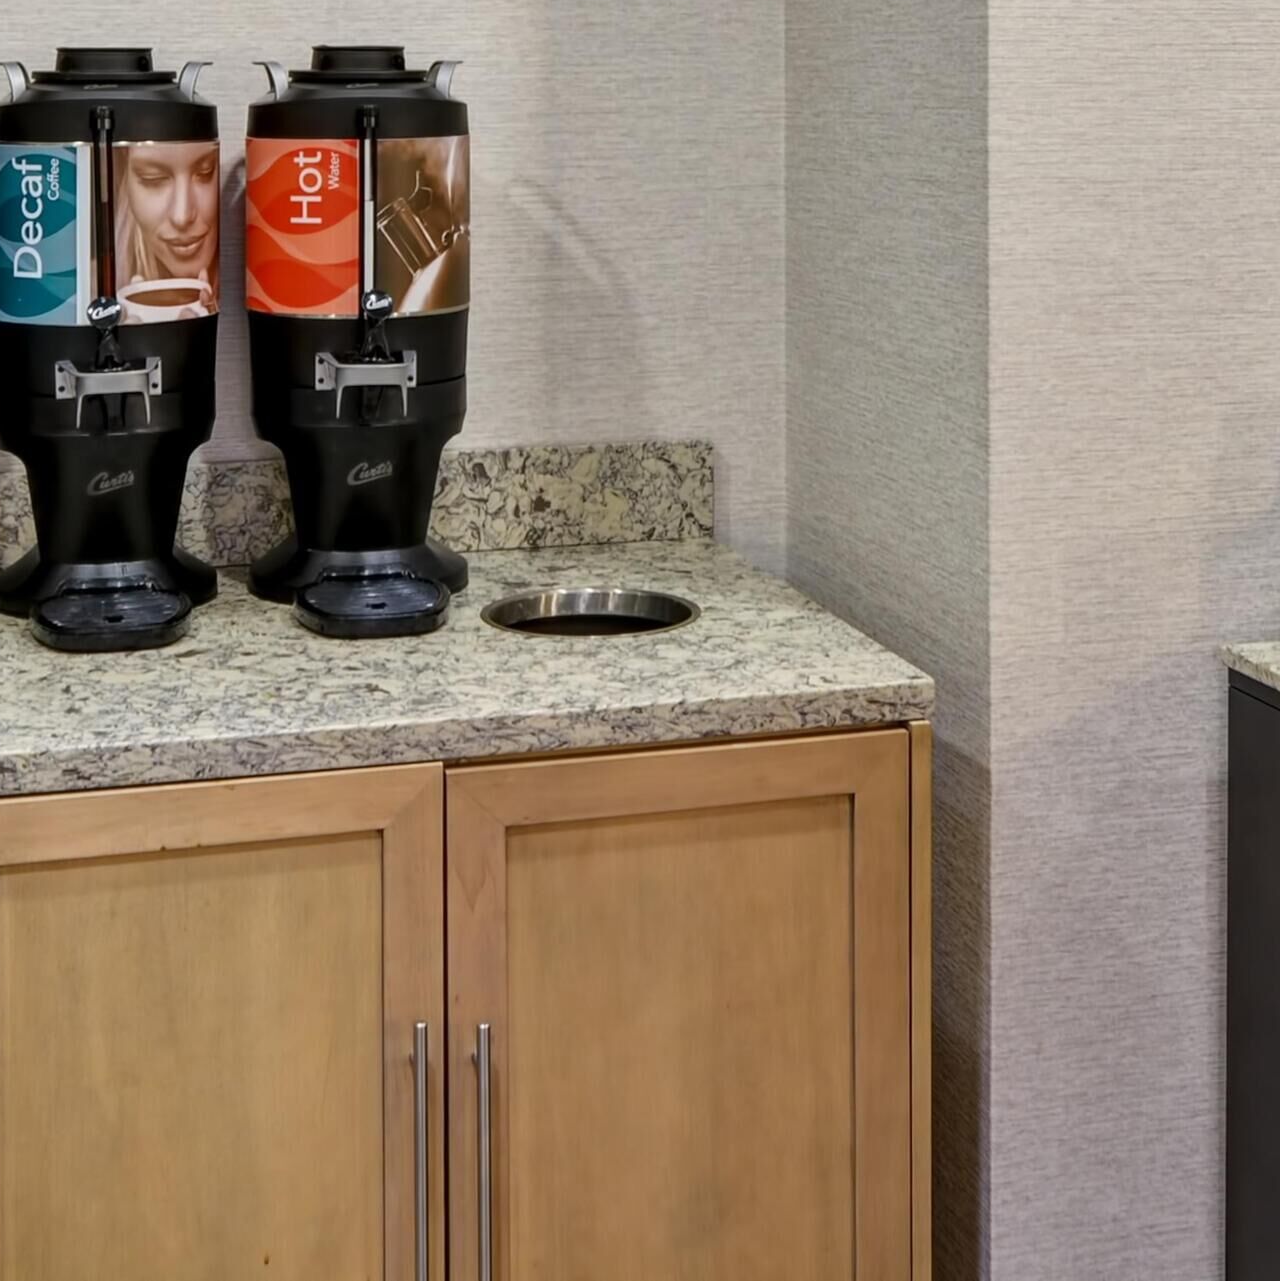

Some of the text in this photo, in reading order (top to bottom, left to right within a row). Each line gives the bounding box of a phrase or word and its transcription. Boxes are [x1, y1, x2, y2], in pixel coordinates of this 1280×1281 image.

[47, 158, 60, 201] Coffee
[290, 151, 322, 224] Hot
[328, 152, 340, 190] Water
[12, 157, 43, 279] Decaf
